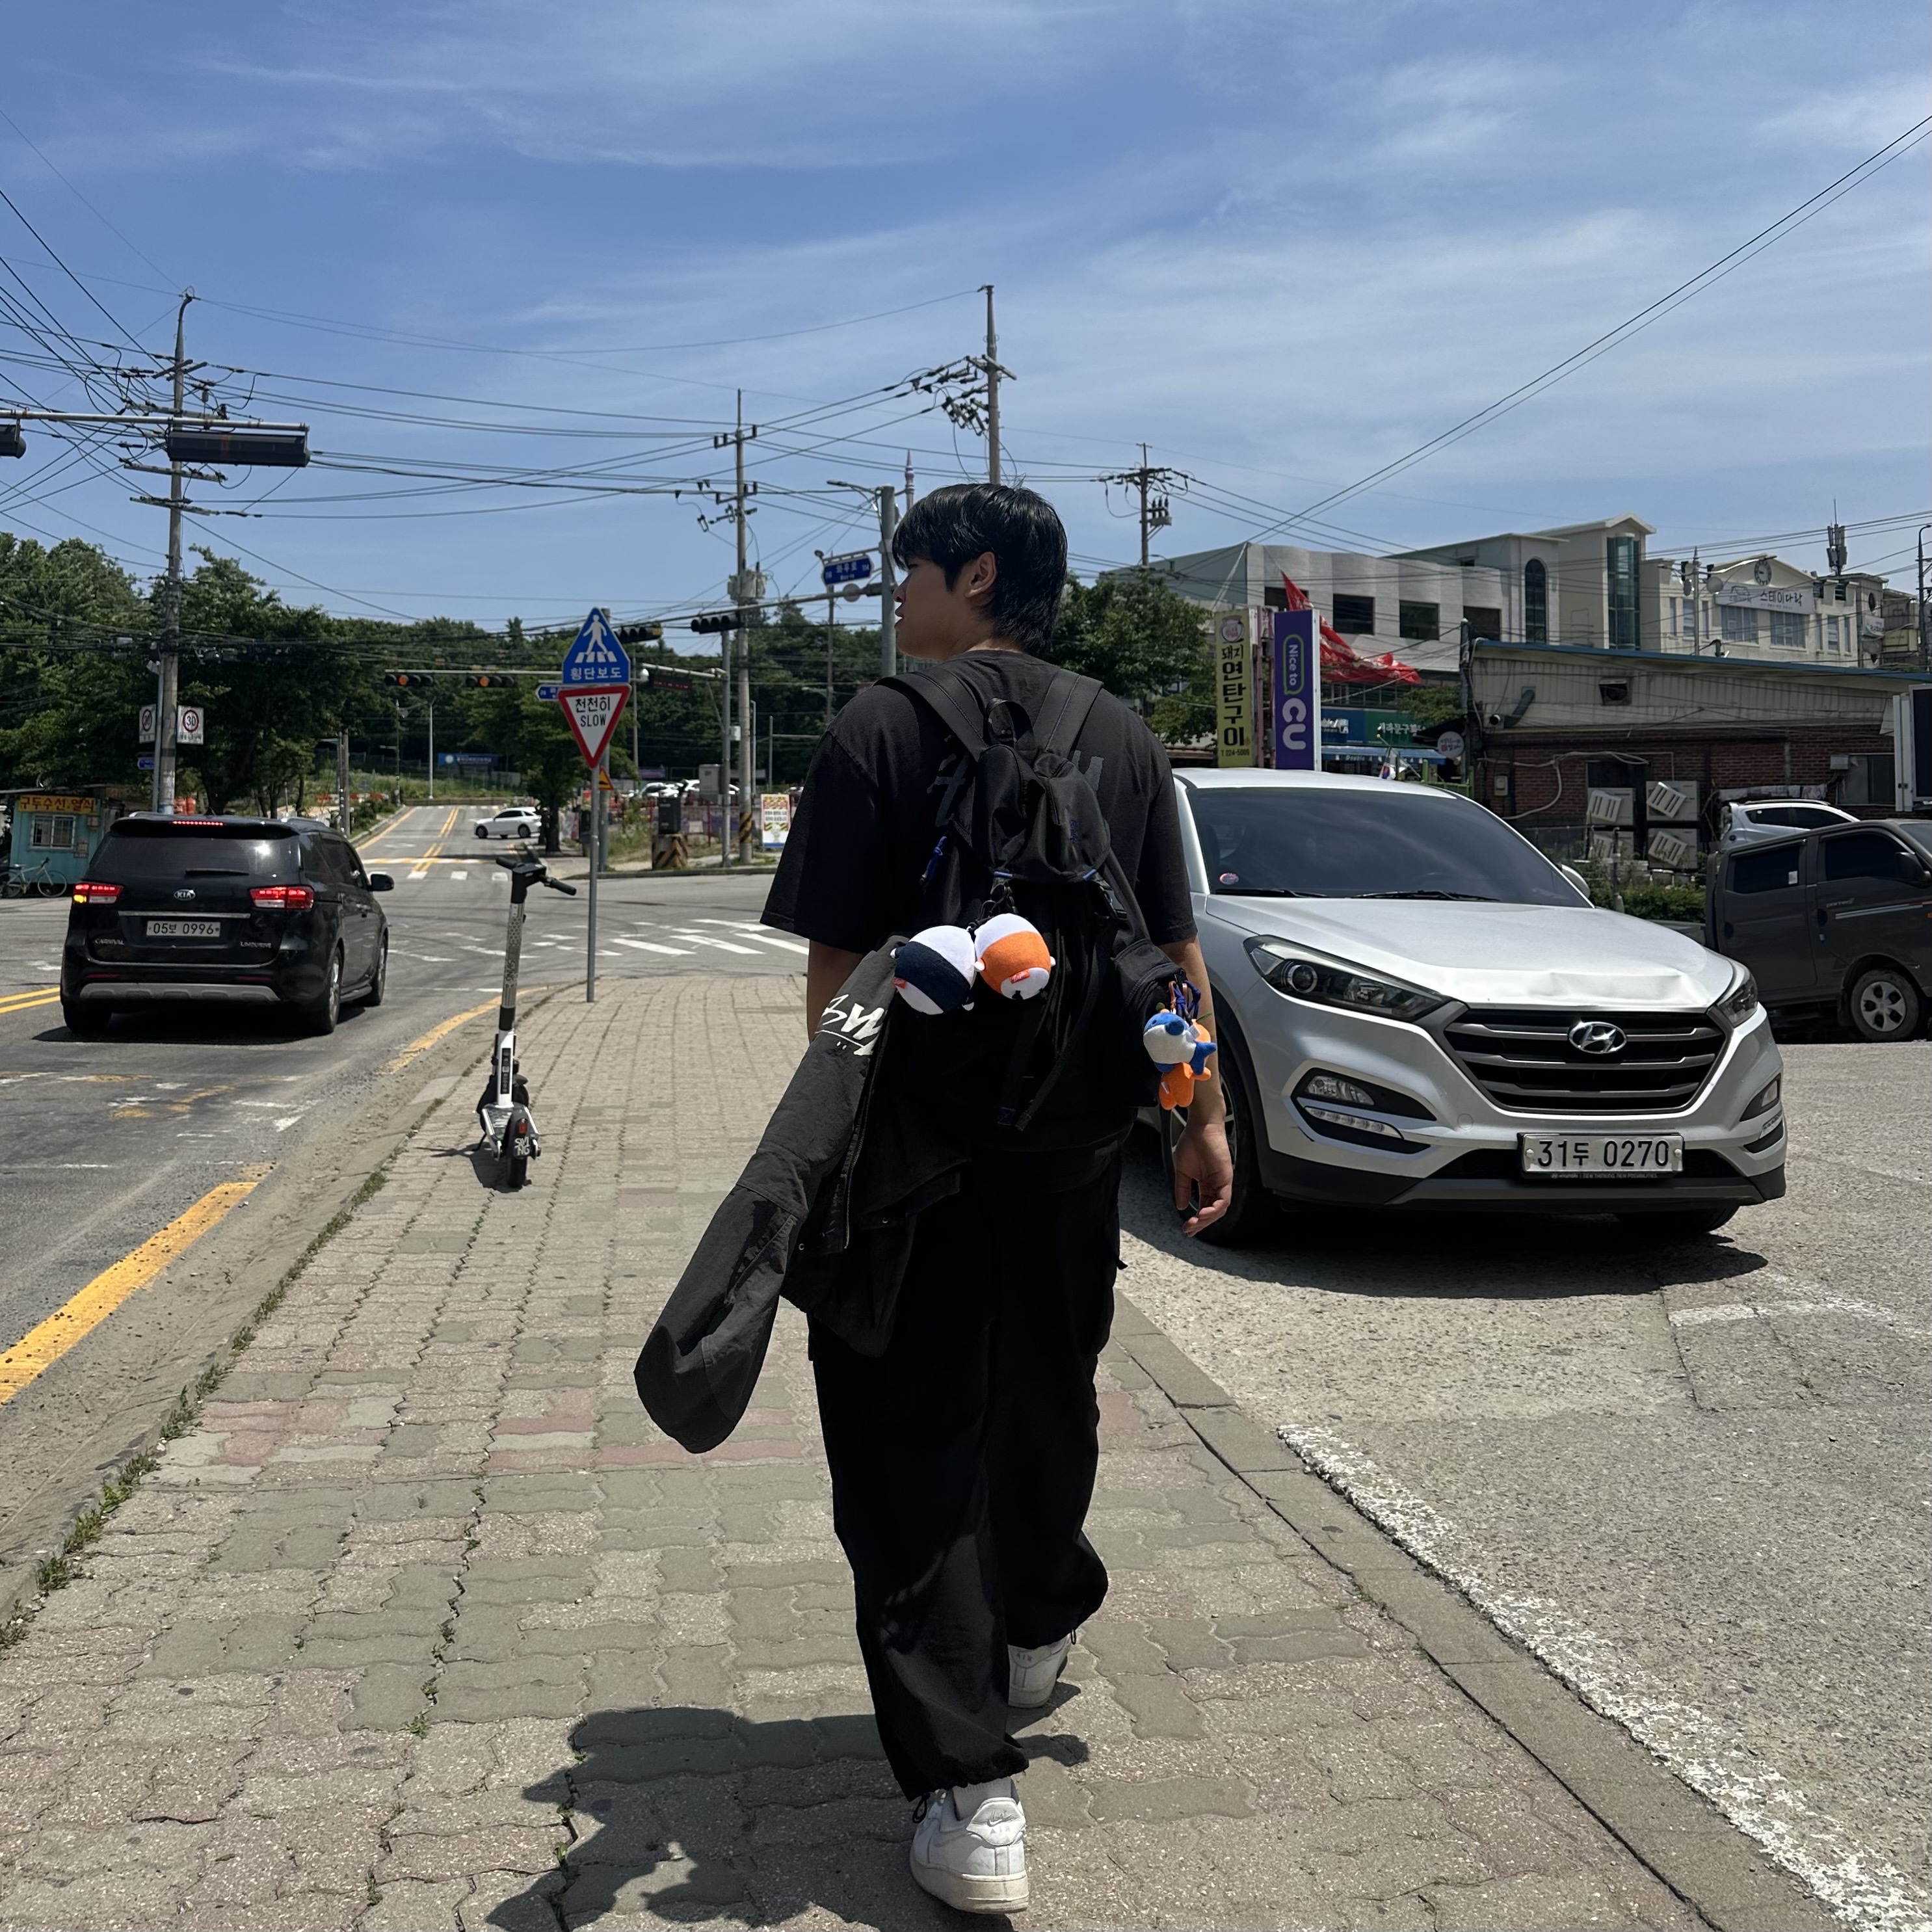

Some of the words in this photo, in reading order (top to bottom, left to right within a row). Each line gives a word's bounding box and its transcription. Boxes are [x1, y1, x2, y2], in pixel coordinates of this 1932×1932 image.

[1760, 590, 1803, 607] 스테이다락
[1222, 644, 1244, 660] 돼지
[1289, 644, 1298, 671] Nice
[570, 667, 622, 680] 횡단보도
[1289, 673, 1298, 686] to
[576, 696, 611, 713] 천천히
[1223, 661, 1247, 747] 연탄구이
[187, 716, 196, 726] 30
[580, 714, 607, 727] SLOW
[1282, 698, 1306, 750] CU
[153, 922, 177, 934] 05보
[182, 923, 214, 934] 0996
[1537, 1141, 1589, 1167] 31두
[1604, 1140, 1669, 1167] 0270
[990, 1826, 1011, 1834] AIR
